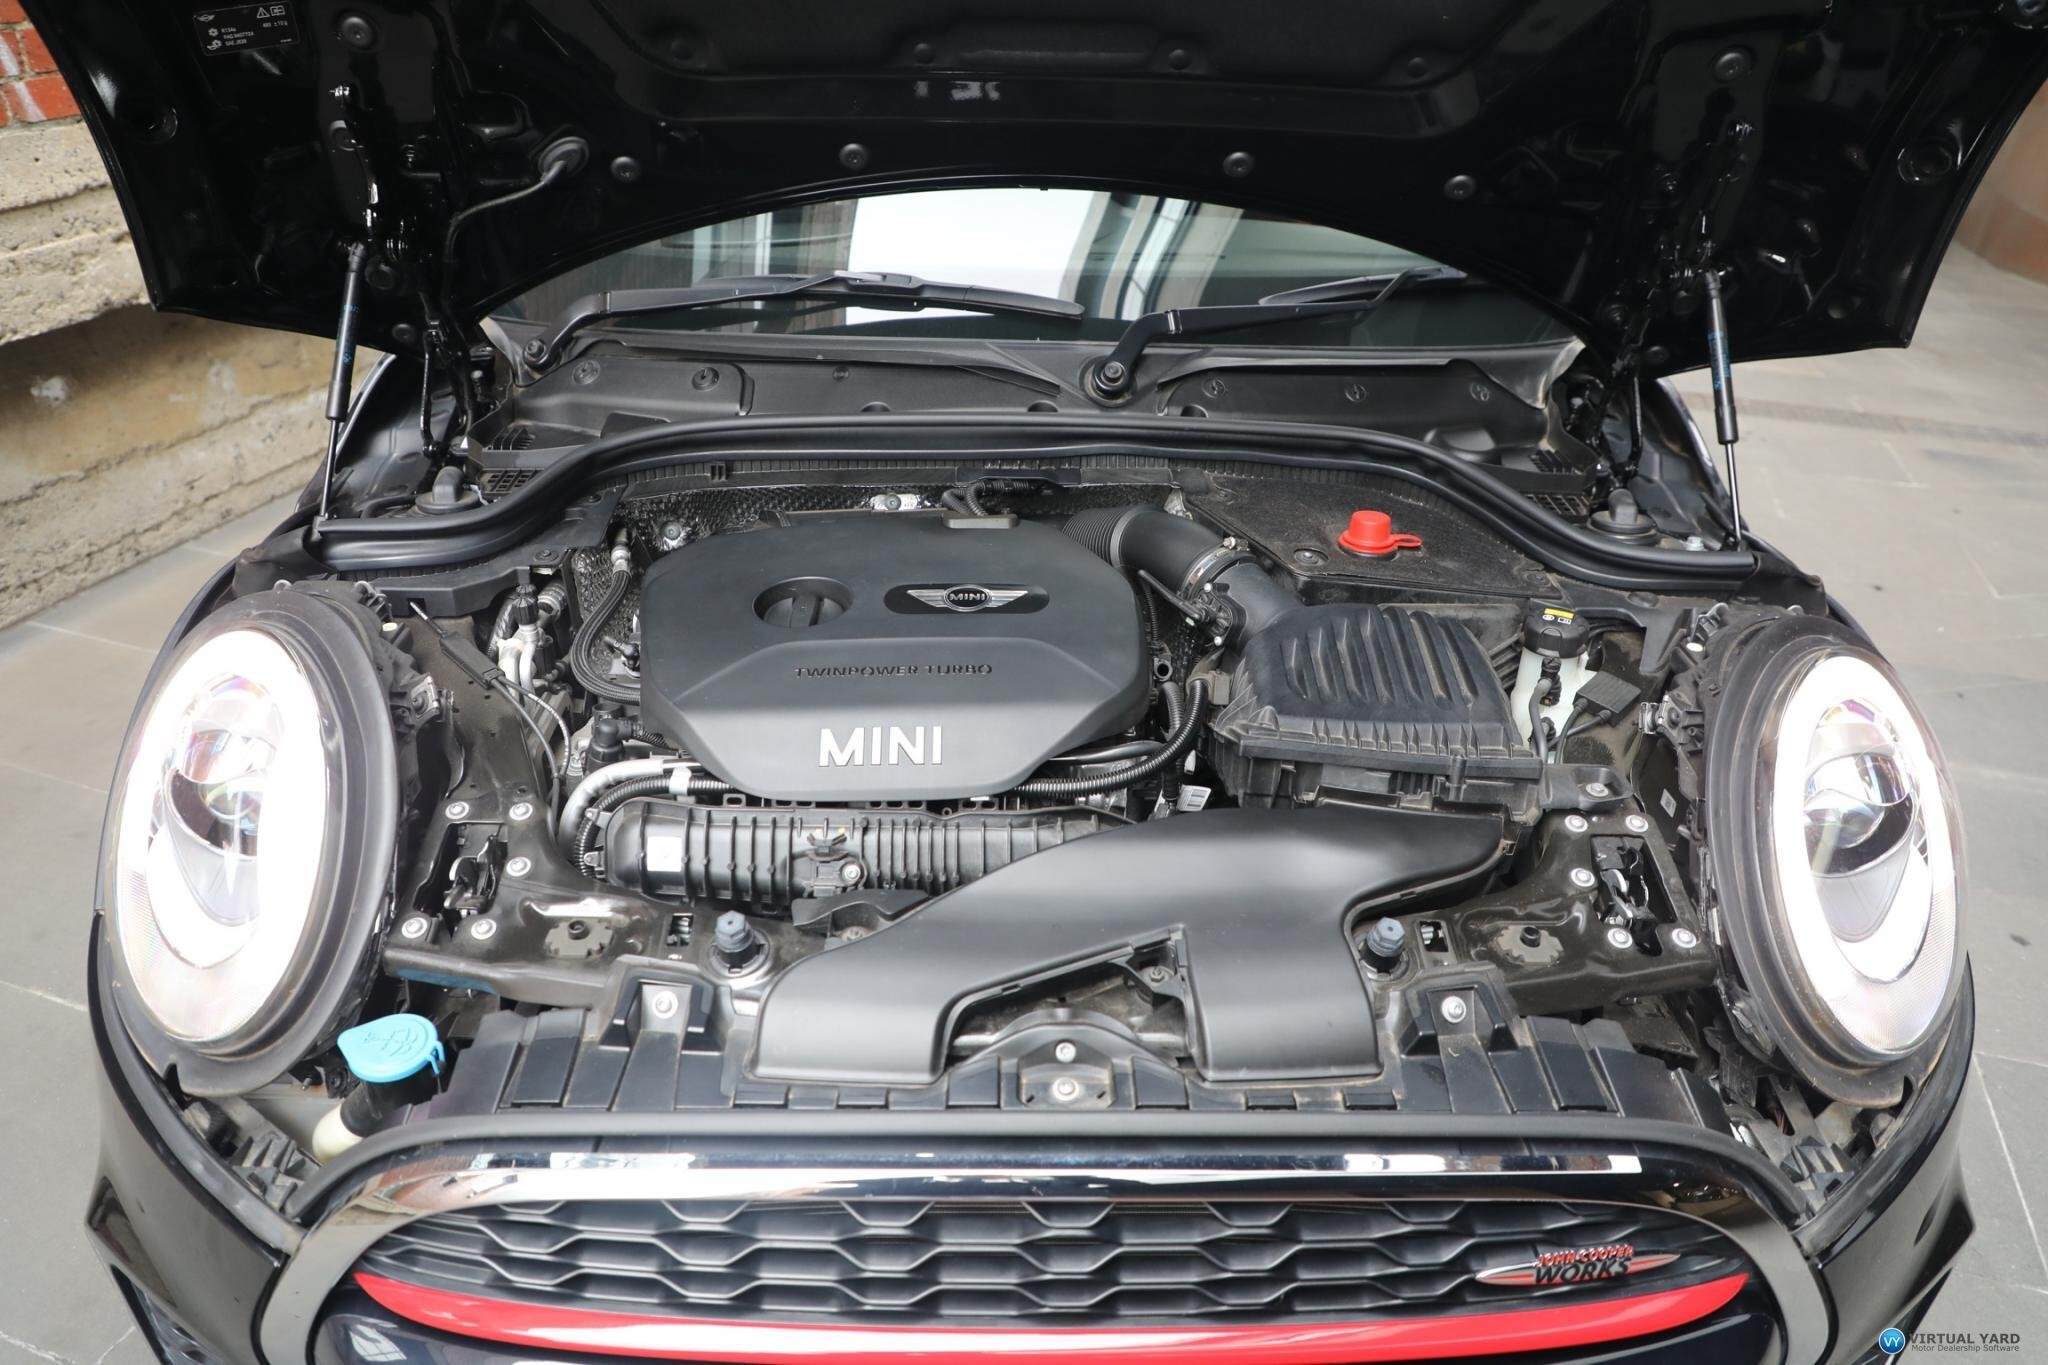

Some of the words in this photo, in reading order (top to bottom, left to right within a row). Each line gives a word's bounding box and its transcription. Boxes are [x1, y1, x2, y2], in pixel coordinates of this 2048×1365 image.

[950, 592, 986, 601] MINI
[795, 664, 919, 677] TWINPOWER
[925, 663, 993, 675] TURBO
[818, 726, 943, 767] MINI
[1536, 1258, 1632, 1283] WORKS
